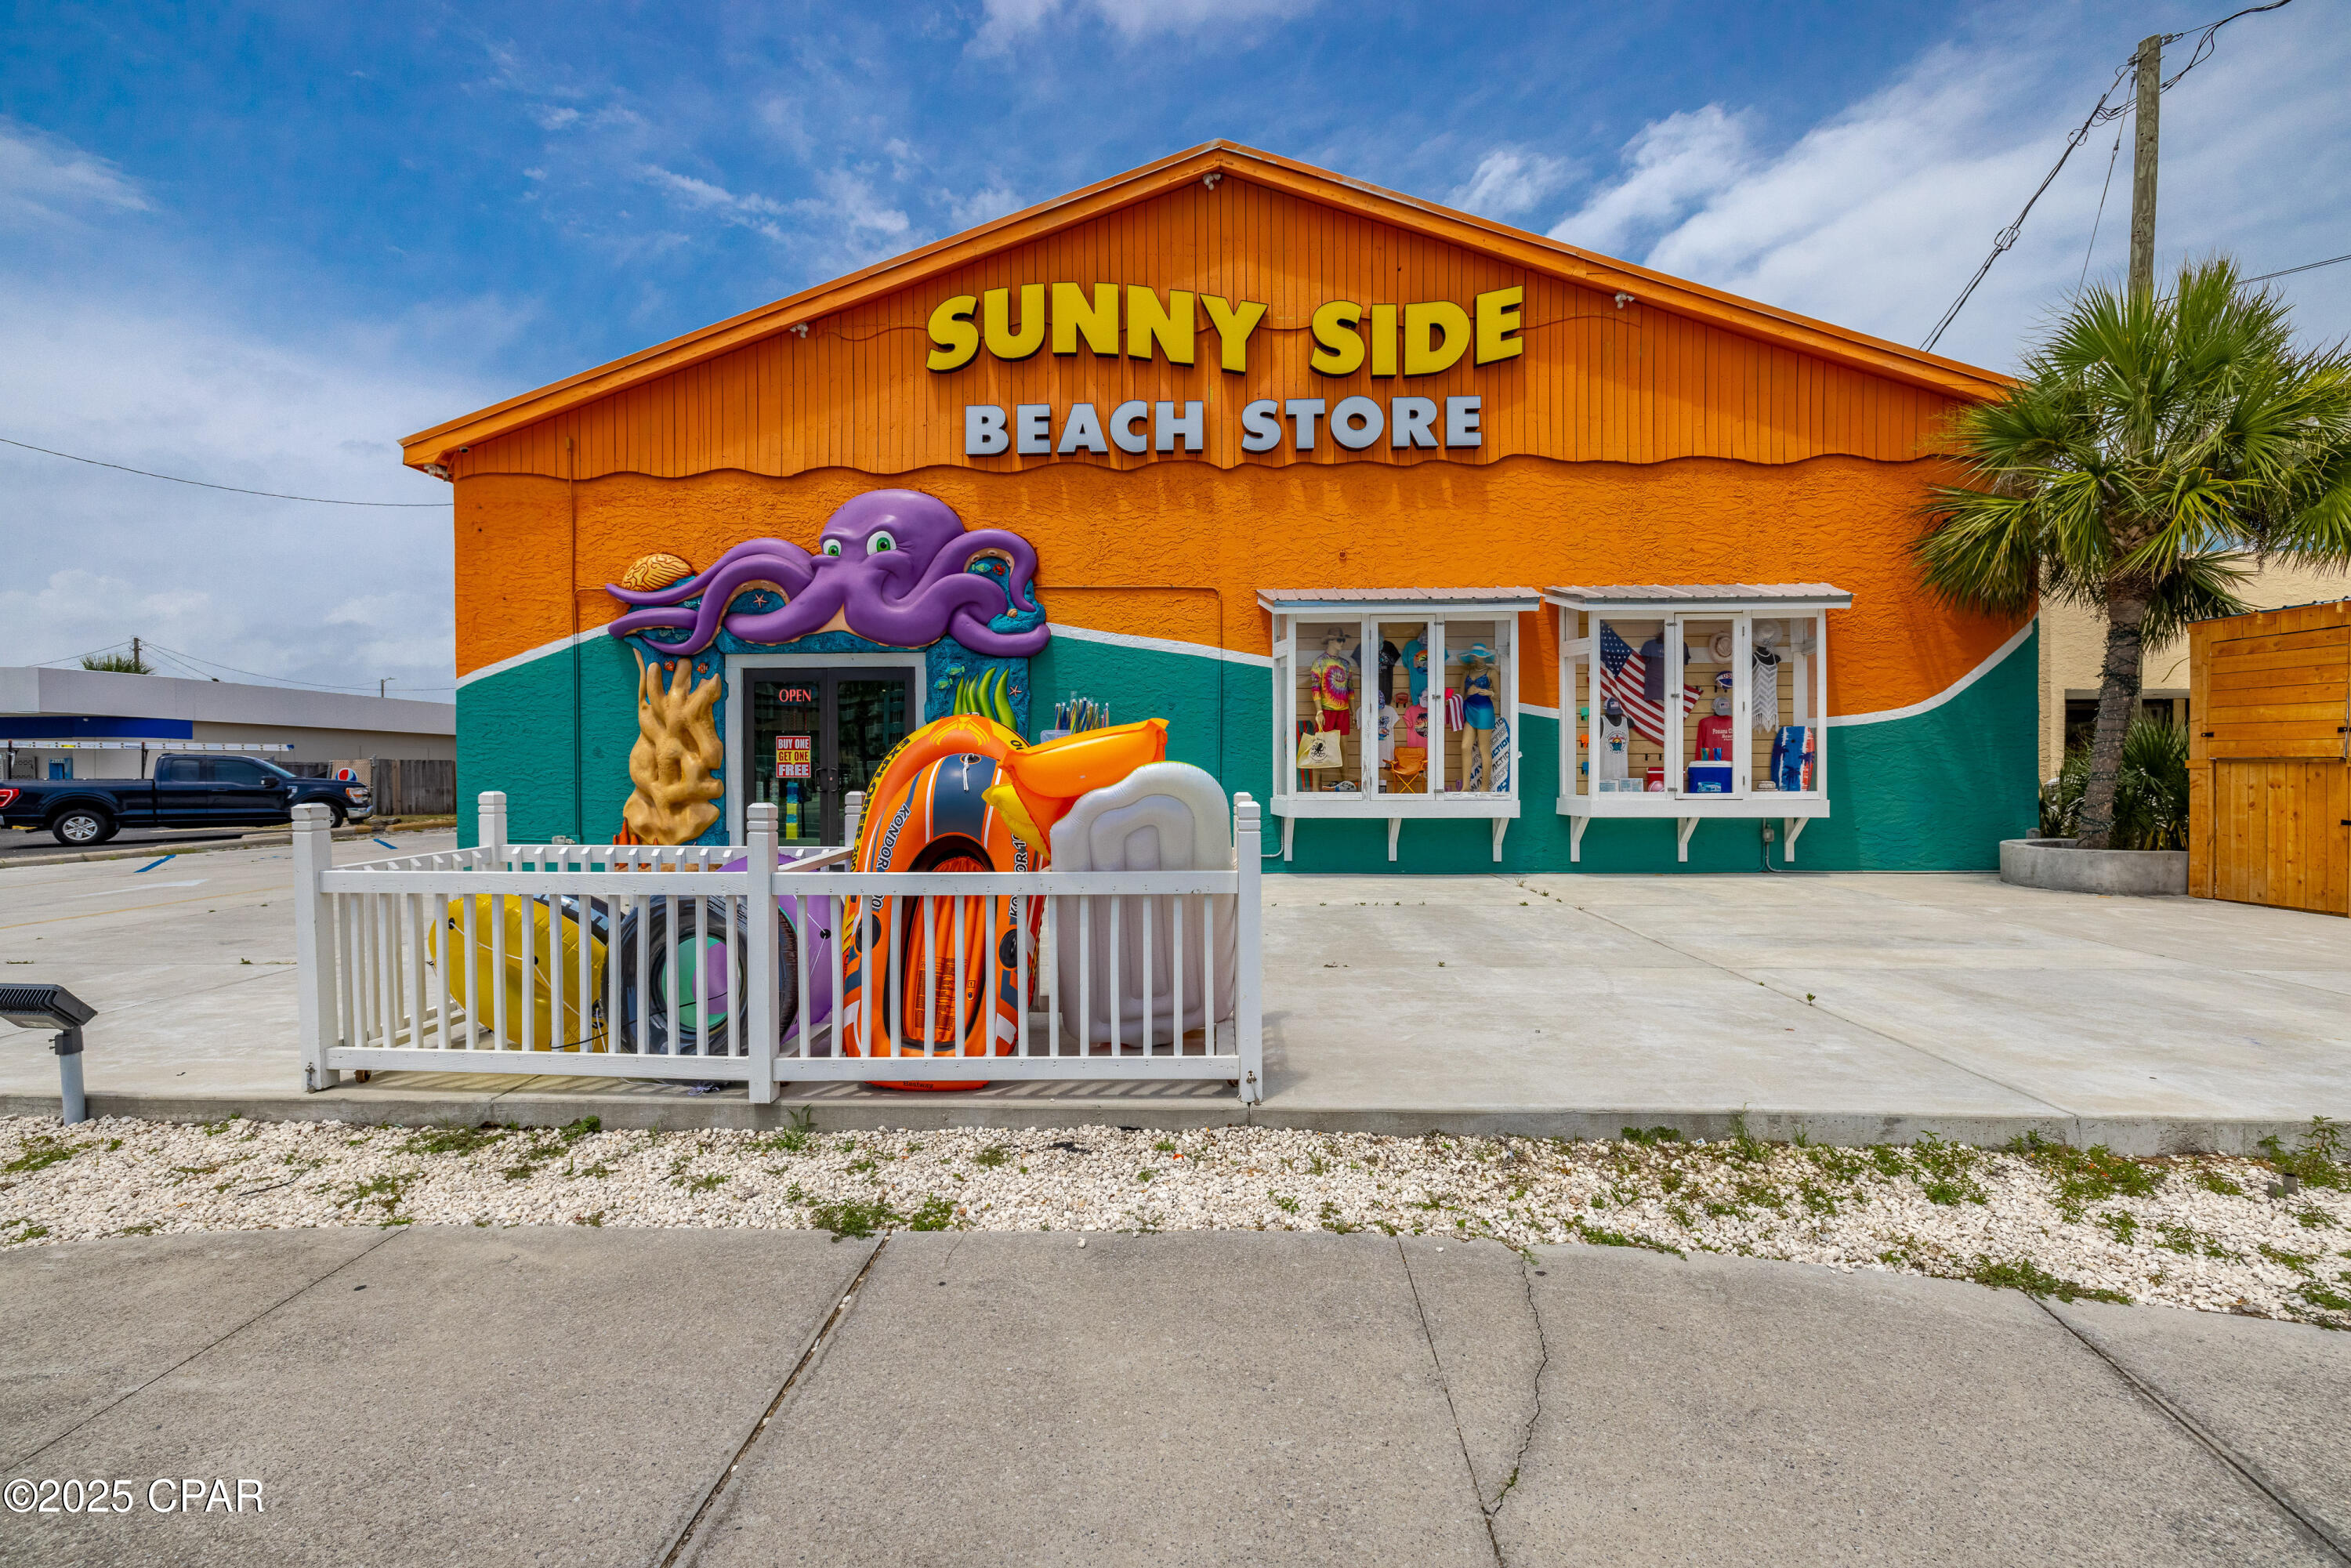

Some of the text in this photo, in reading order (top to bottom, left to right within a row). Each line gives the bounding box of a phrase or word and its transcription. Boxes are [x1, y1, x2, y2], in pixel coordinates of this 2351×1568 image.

[926, 282, 1524, 378] SUNNY SIDE
[965, 395, 1483, 457] BEACH STORE
[779, 689, 811, 702] OPEN
[778, 739, 810, 749] BUY ONE
[779, 751, 809, 762] GET ONE
[779, 764, 809, 777] FREE
[850, 737, 911, 872] EXPLORER 200
[876, 803, 911, 870] KONDOR
